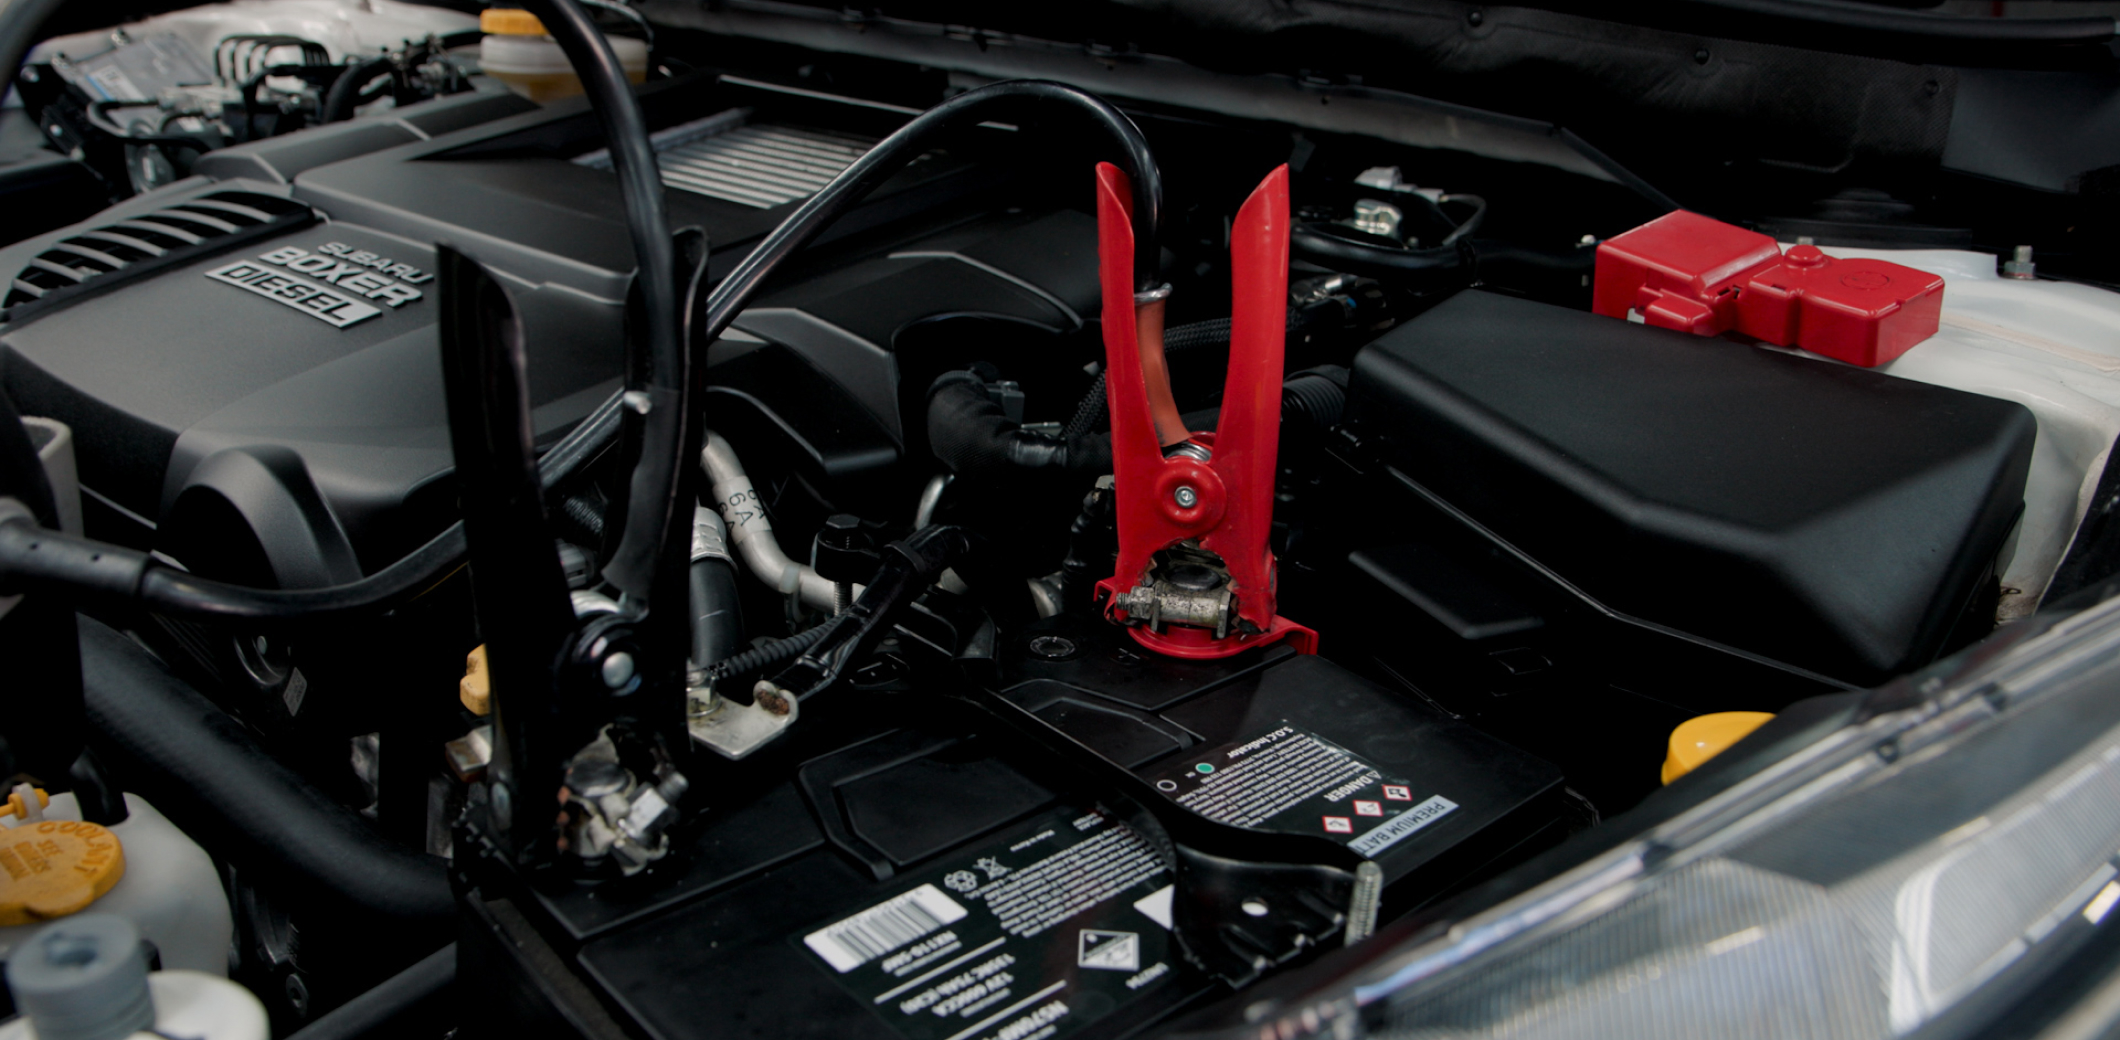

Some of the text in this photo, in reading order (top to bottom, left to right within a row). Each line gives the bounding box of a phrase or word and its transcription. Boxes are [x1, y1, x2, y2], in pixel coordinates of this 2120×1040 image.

[258, 245, 423, 308] BOXER
[318, 241, 434, 284] SUBARU
[217, 263, 354, 322] DIESEL
[729, 492, 754, 527] 6A
[1227, 734, 1271, 759] Indicator
[1323, 774, 1374, 802] DANGER
[1387, 801, 1446, 836] PREMIUM
